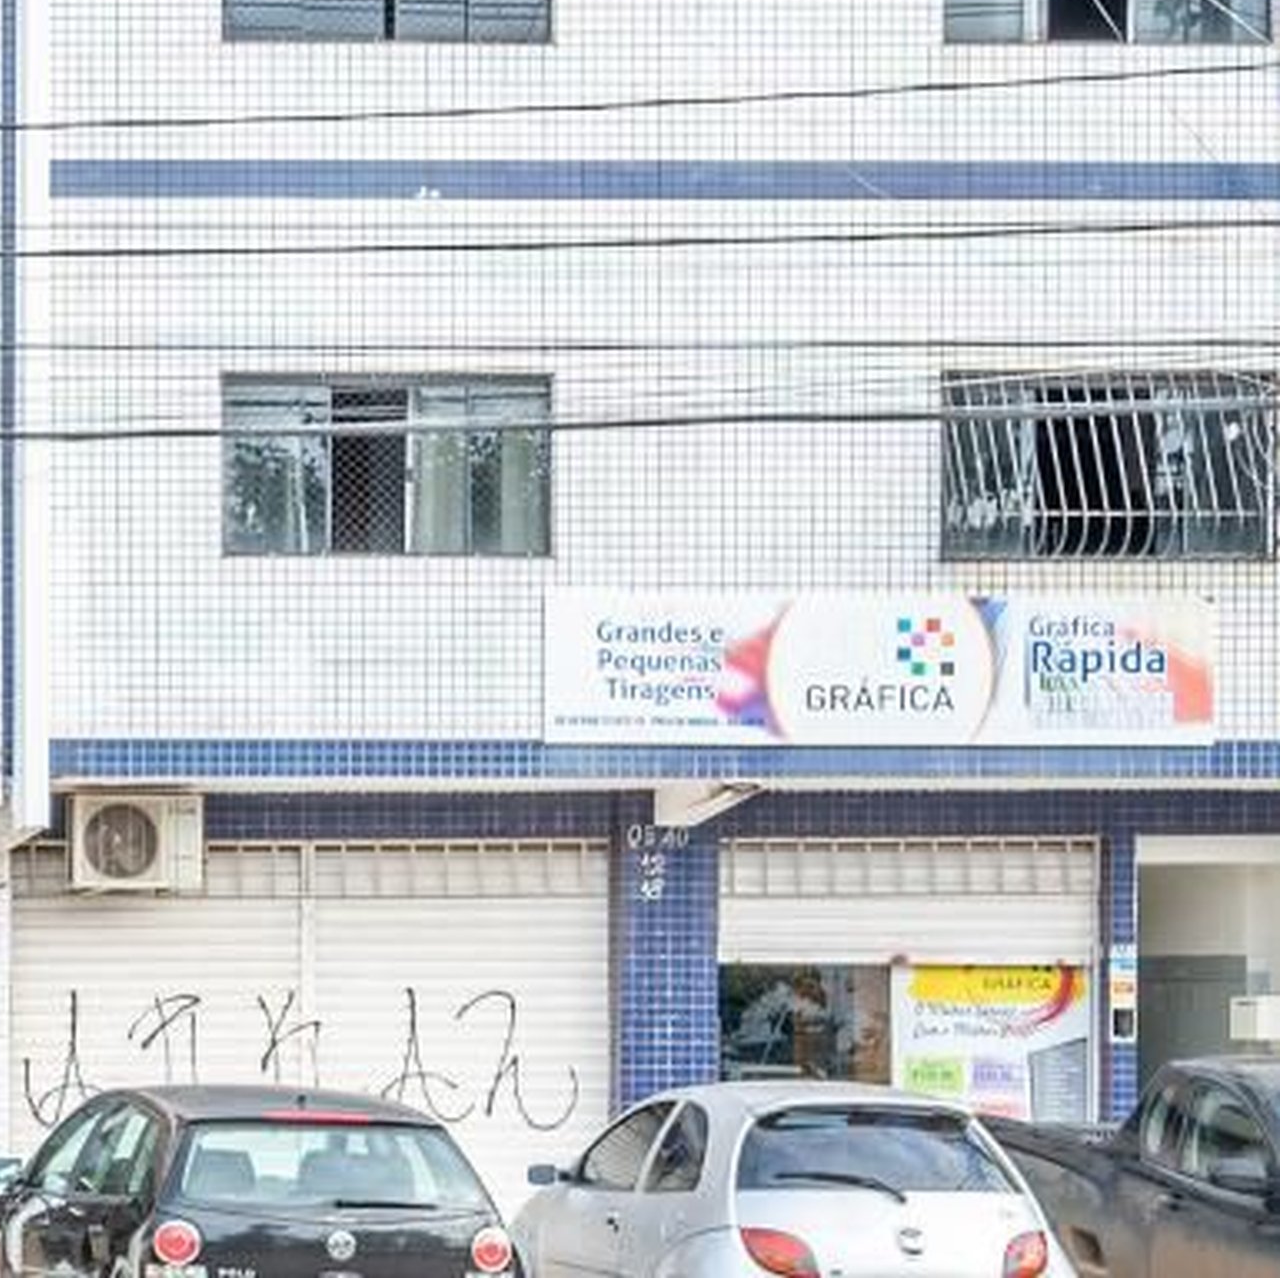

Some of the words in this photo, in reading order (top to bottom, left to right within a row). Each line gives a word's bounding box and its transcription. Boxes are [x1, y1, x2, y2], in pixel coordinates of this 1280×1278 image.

[596, 620, 703, 644] Grandes
[708, 626, 725, 644] e
[596, 647, 723, 677] Pequenas
[605, 676, 717, 707] Tiragens
[805, 679, 956, 713] GRÁFICA
